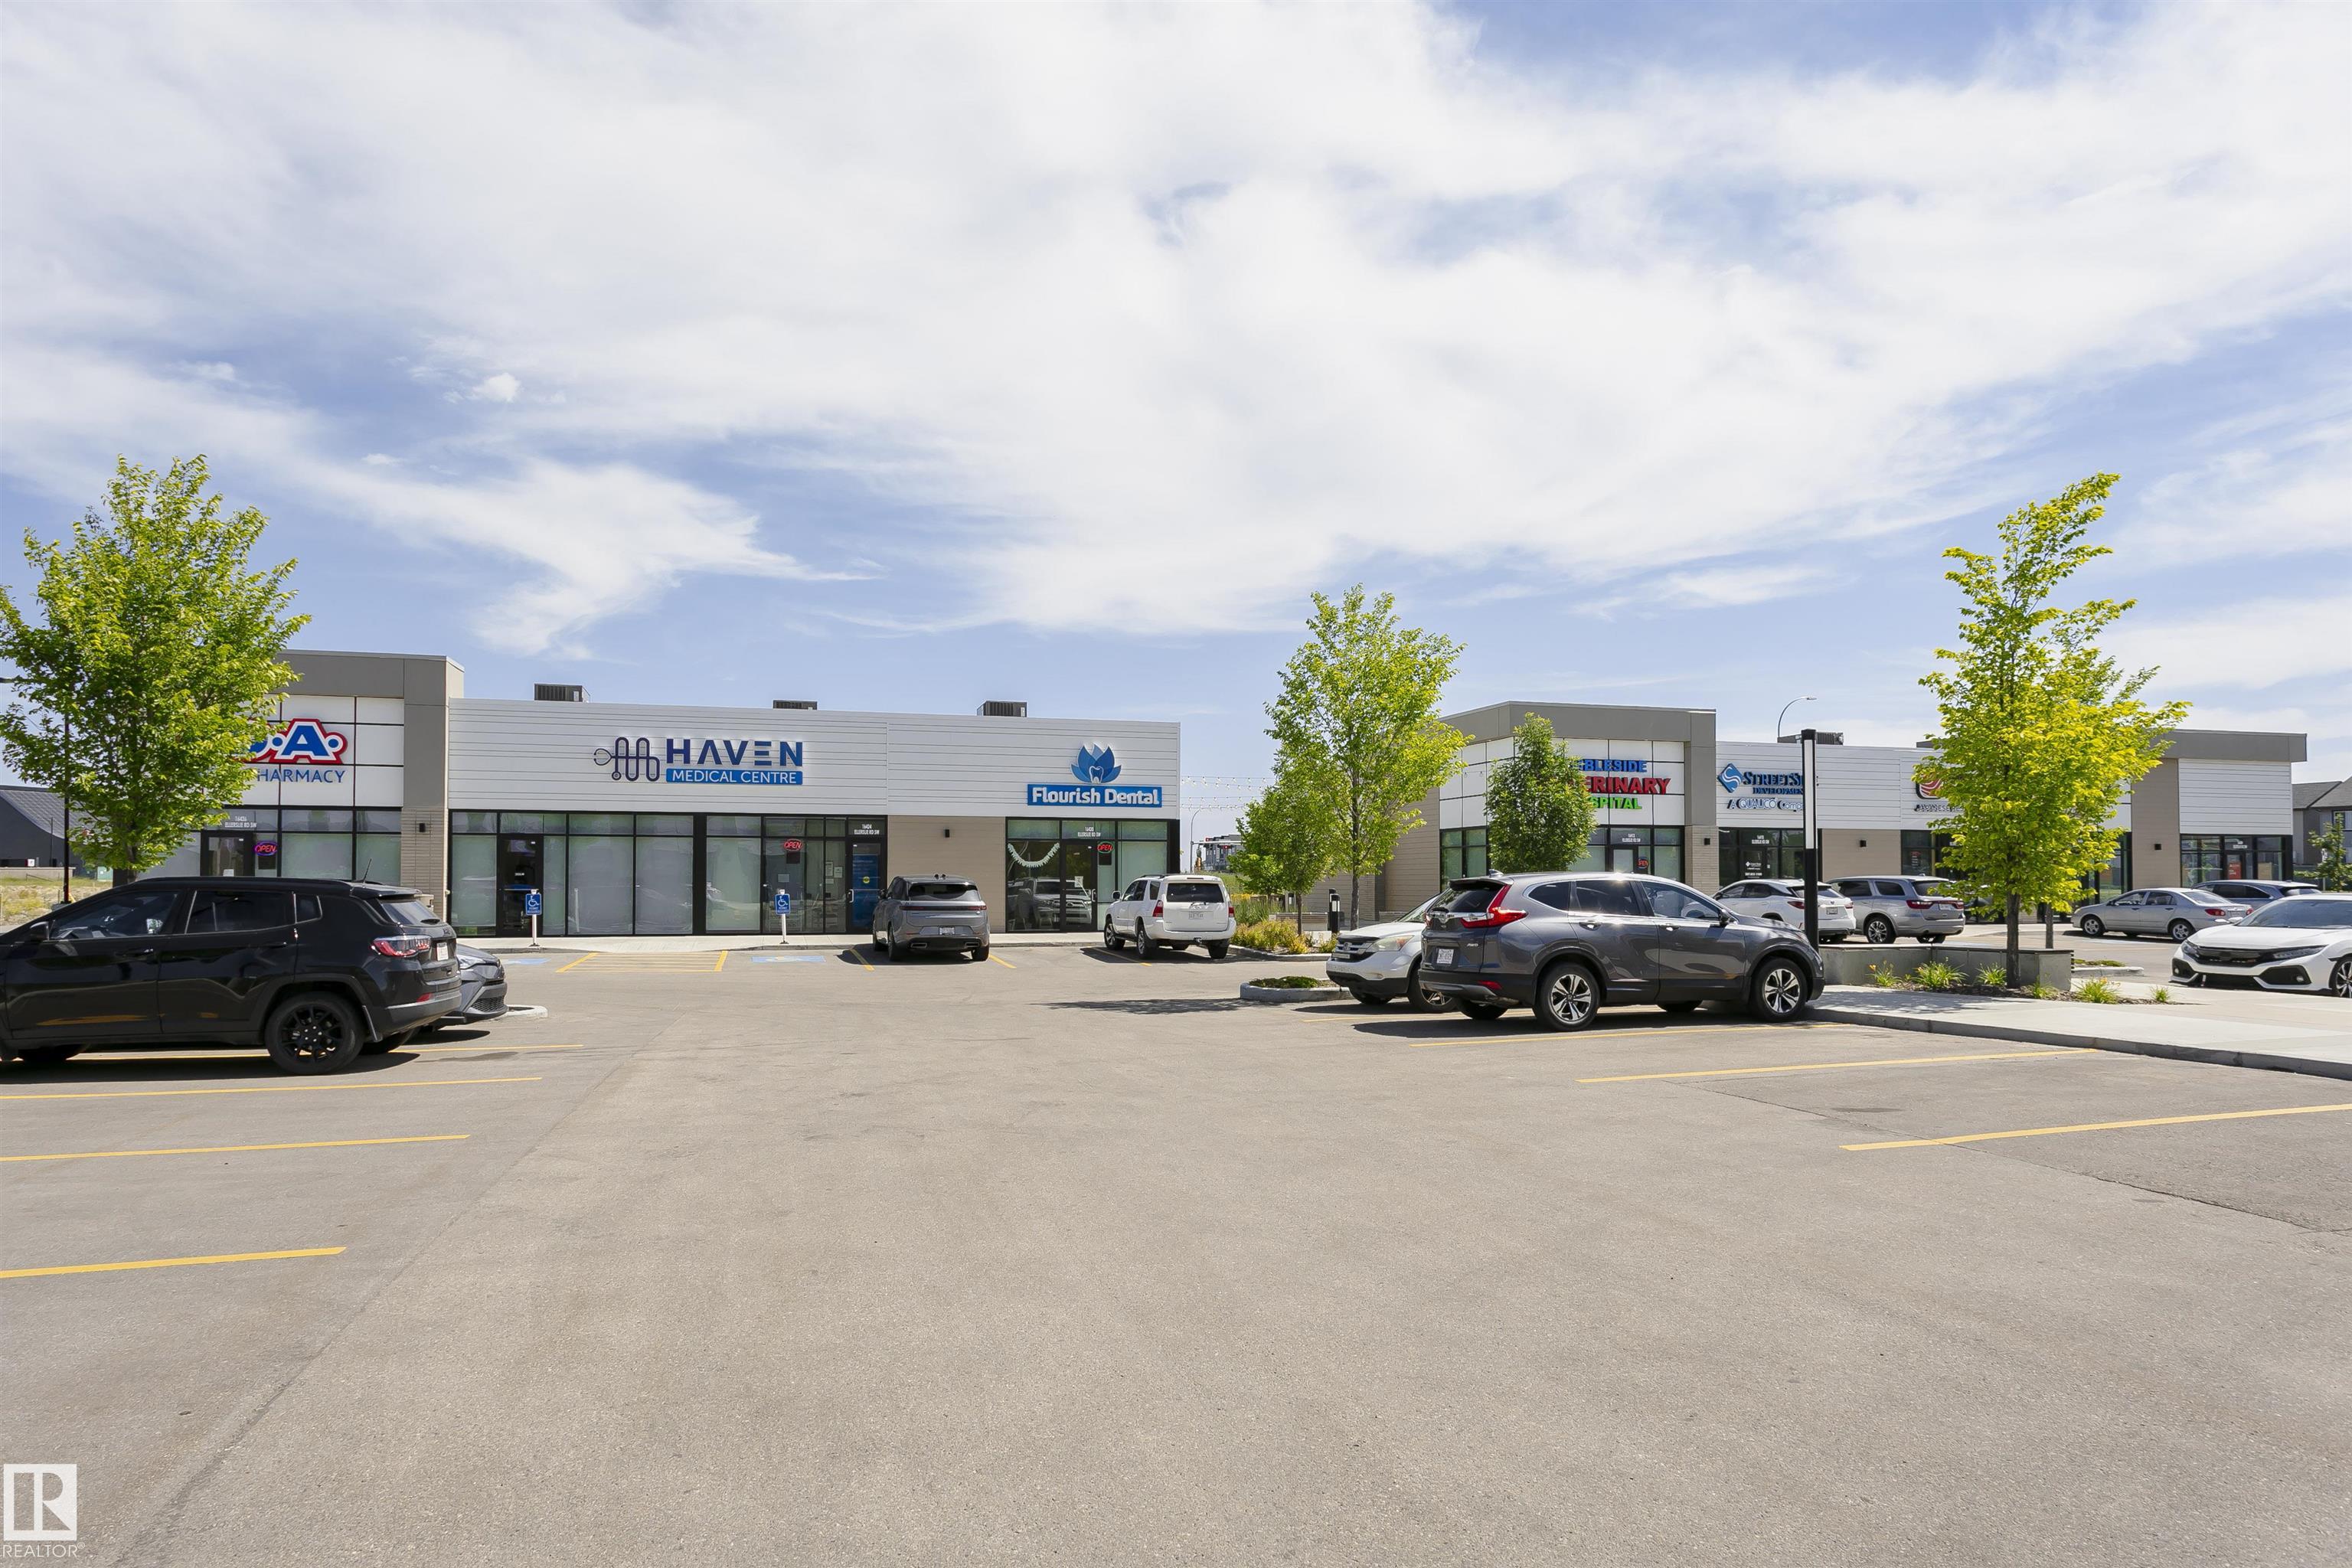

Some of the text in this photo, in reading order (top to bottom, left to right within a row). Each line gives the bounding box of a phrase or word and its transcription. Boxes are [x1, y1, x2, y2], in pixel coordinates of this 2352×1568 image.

[666, 738, 803, 766] HAVEN
[1578, 759, 1648, 773] BLESIDE
[256, 769, 345, 782] HARMACY
[672, 770, 797, 783] MEDICAL CENTRE
[1586, 776, 1671, 795] ERINARY
[1032, 787, 1160, 805] Flourish Dental
[1589, 797, 1642, 809] SPITAL
[1777, 800, 1803, 812] Comp
